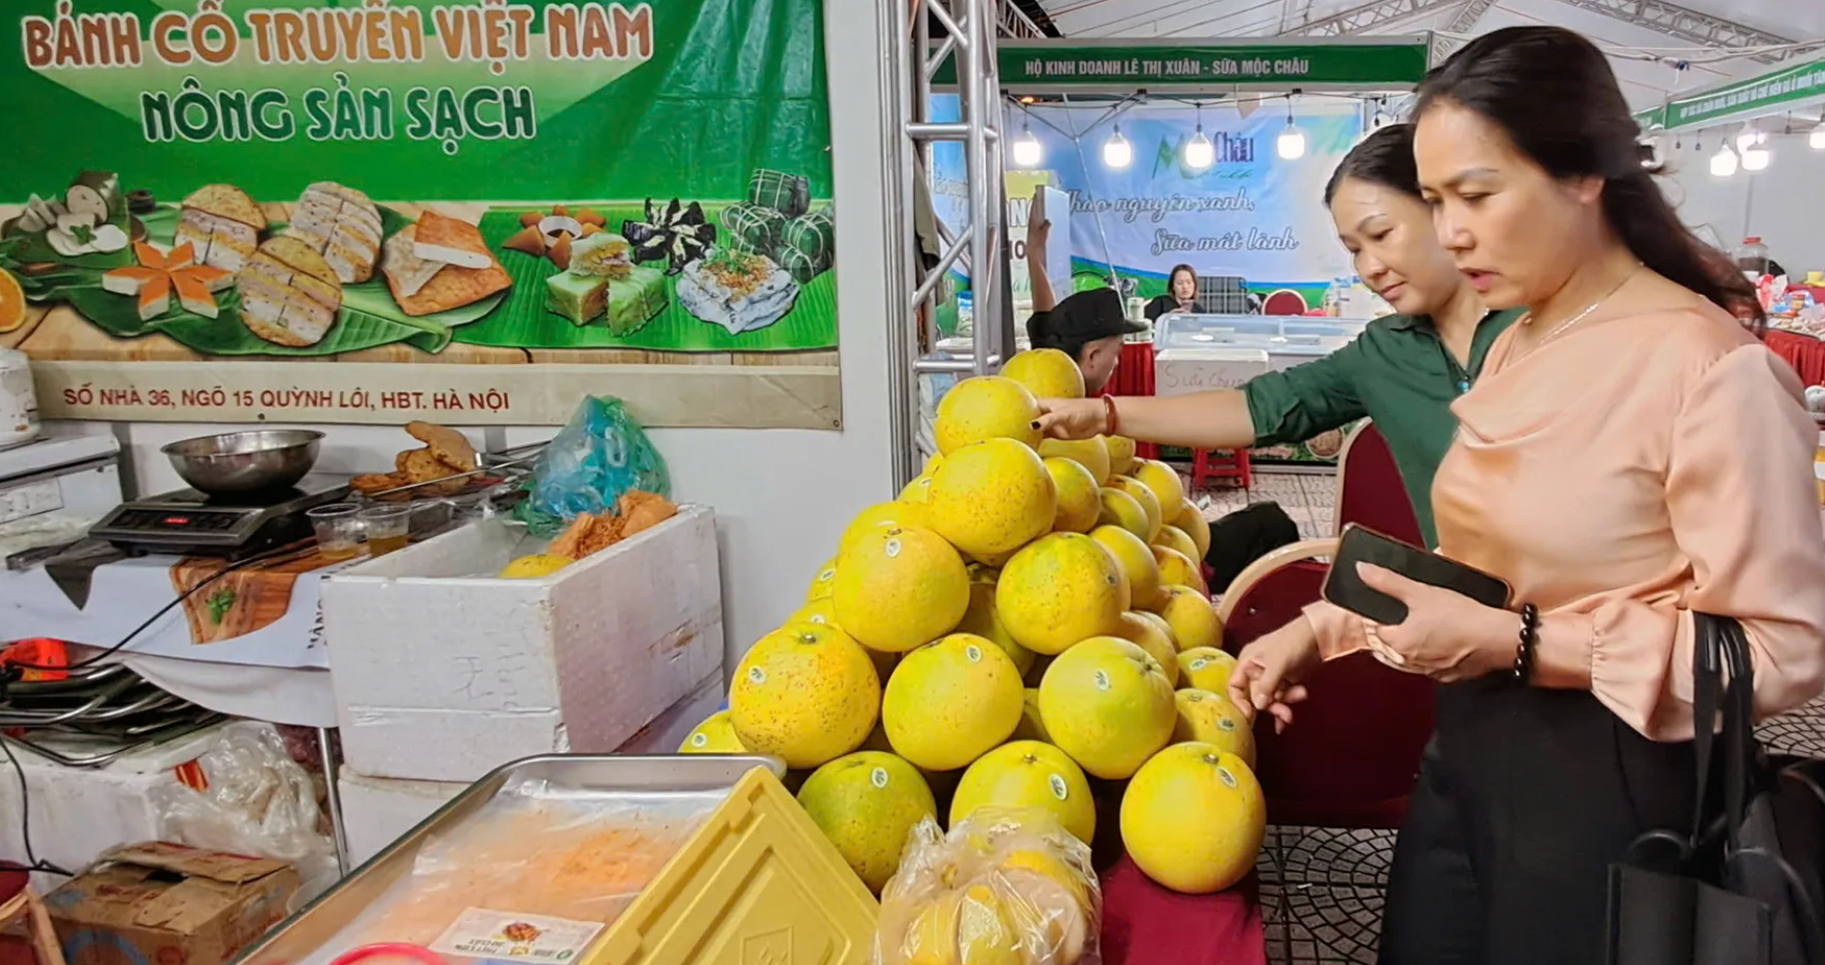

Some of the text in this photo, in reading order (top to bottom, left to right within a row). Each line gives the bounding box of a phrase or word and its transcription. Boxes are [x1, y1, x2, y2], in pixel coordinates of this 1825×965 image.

[23, 0, 142, 67] BÁNH
[433, 0, 535, 75] VIỆT
[545, 3, 653, 59] NAM
[1025, 58, 1042, 78] HỘ
[1046, 61, 1075, 75] KINH
[1079, 61, 1121, 75] DOANH
[1124, 57, 1138, 75] LÊ
[1143, 61, 1162, 78] THỊ
[1165, 57, 1200, 75] XUÂN
[1212, 57, 1238, 75] SỮA
[1241, 57, 1271, 77] MỘC
[1274, 57, 1309, 75] CHÂU
[140, 72, 536, 155] NÔNG SẢN SẠCH
[1212, 131, 1254, 163] Châu
[1114, 193, 1195, 223] nguyên
[1246, 226, 1299, 250] lành
[63, 382, 93, 406] SỐ
[100, 384, 143, 406] NHÀ
[148, 389, 176, 409] 36,
[182, 385, 226, 407] NGÕ
[232, 390, 254, 407] 15
[260, 386, 333, 408] QUỲNH
[381, 391, 427, 410] HBT.
[433, 389, 463, 410] HÀ
[469, 388, 510, 413] NỘI
